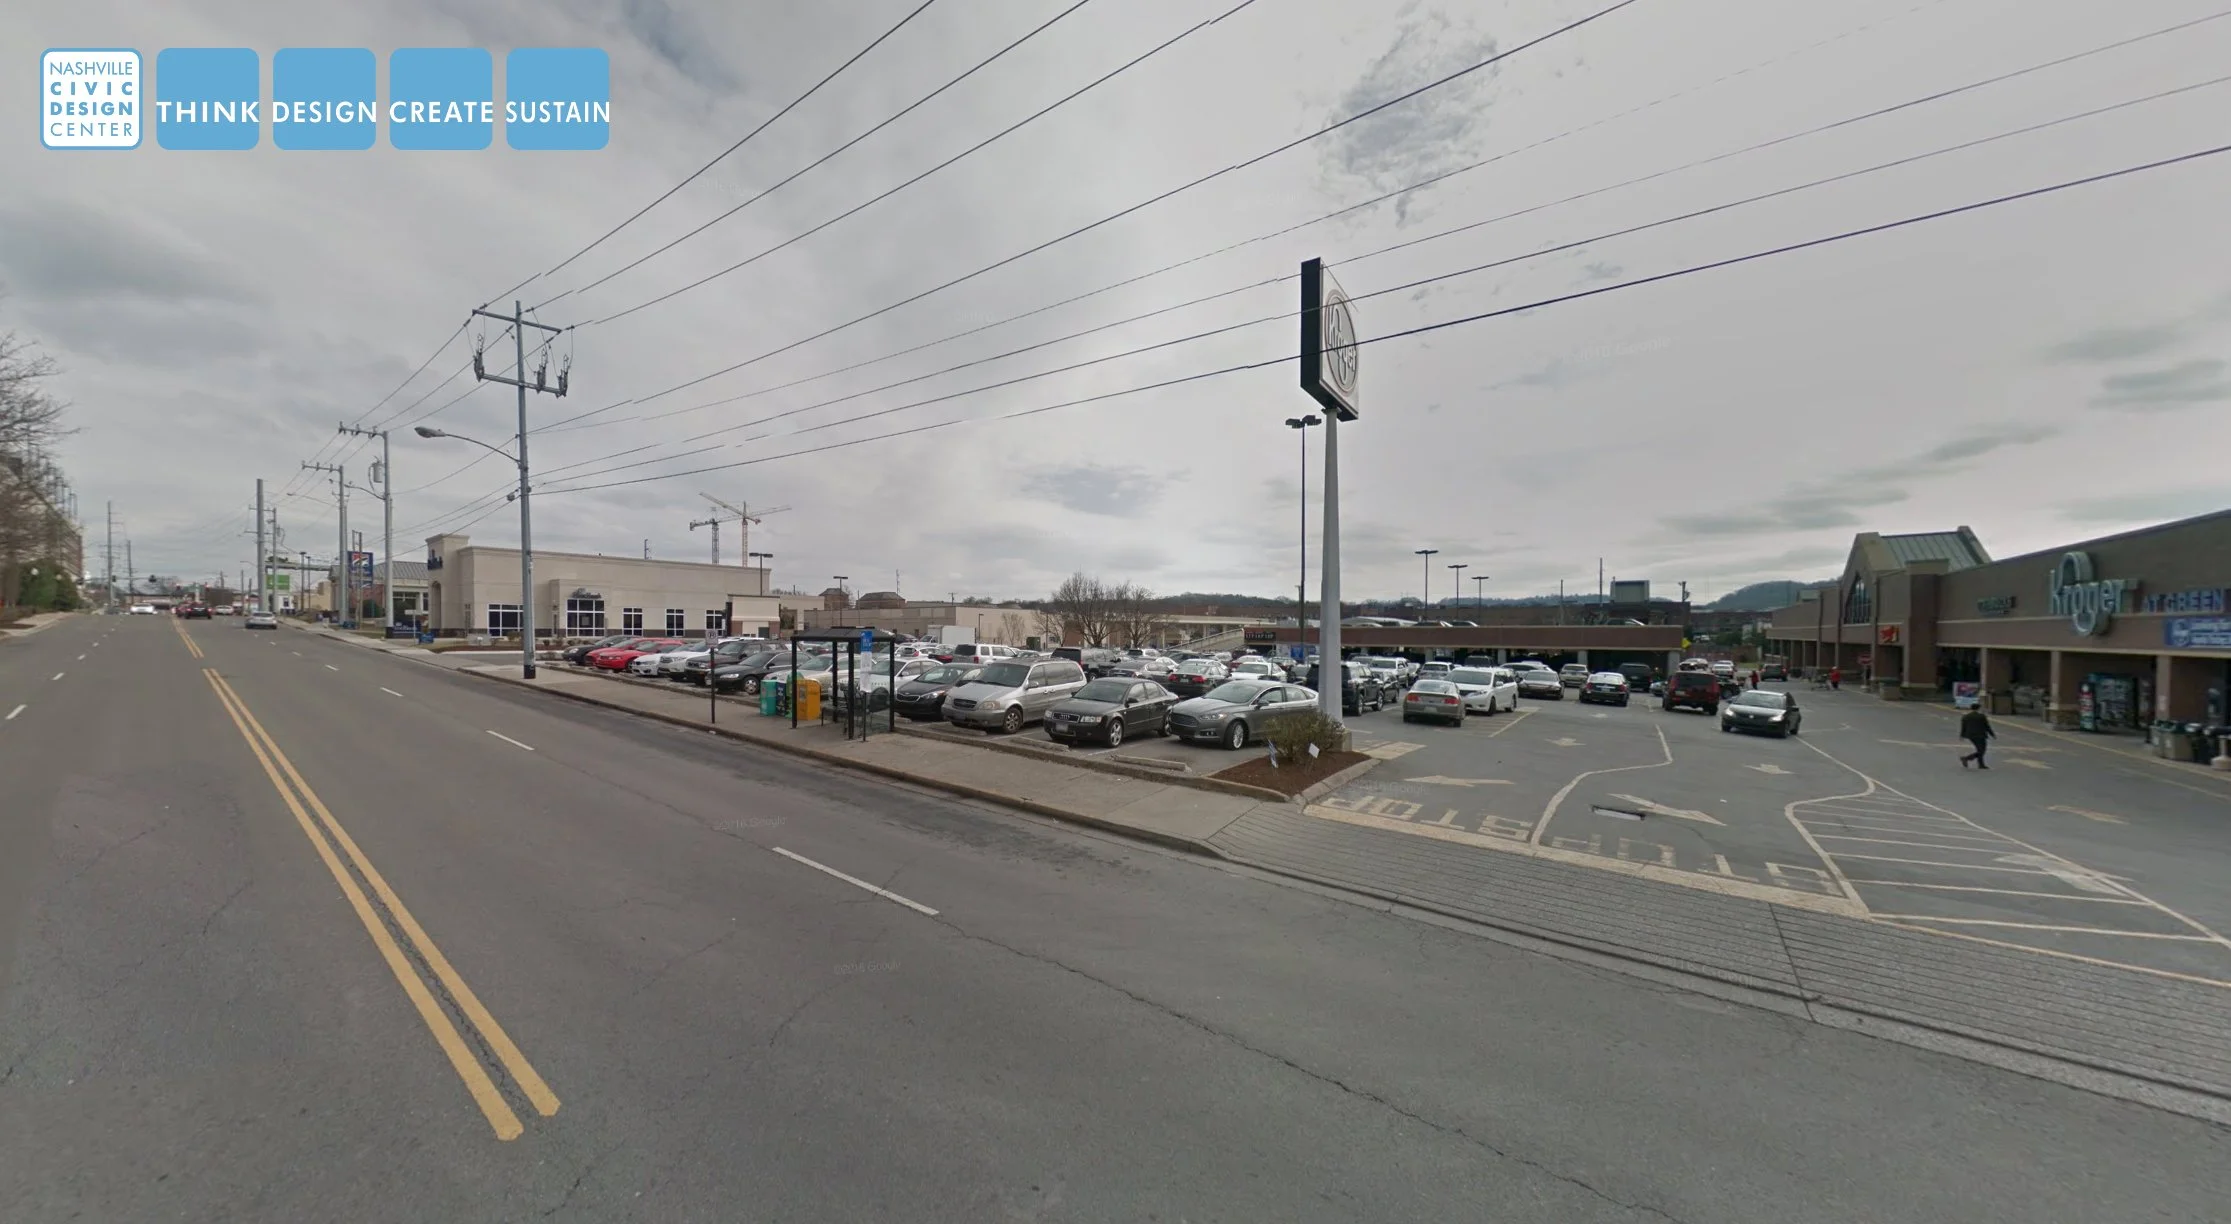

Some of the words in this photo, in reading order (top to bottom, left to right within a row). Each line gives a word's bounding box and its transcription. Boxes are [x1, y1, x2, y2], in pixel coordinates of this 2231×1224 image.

[1328, 302, 1358, 386] Kroger
[2049, 552, 2138, 636] Kroger
[2163, 587, 2225, 613] GREEN
[1321, 795, 1534, 841] STOP
